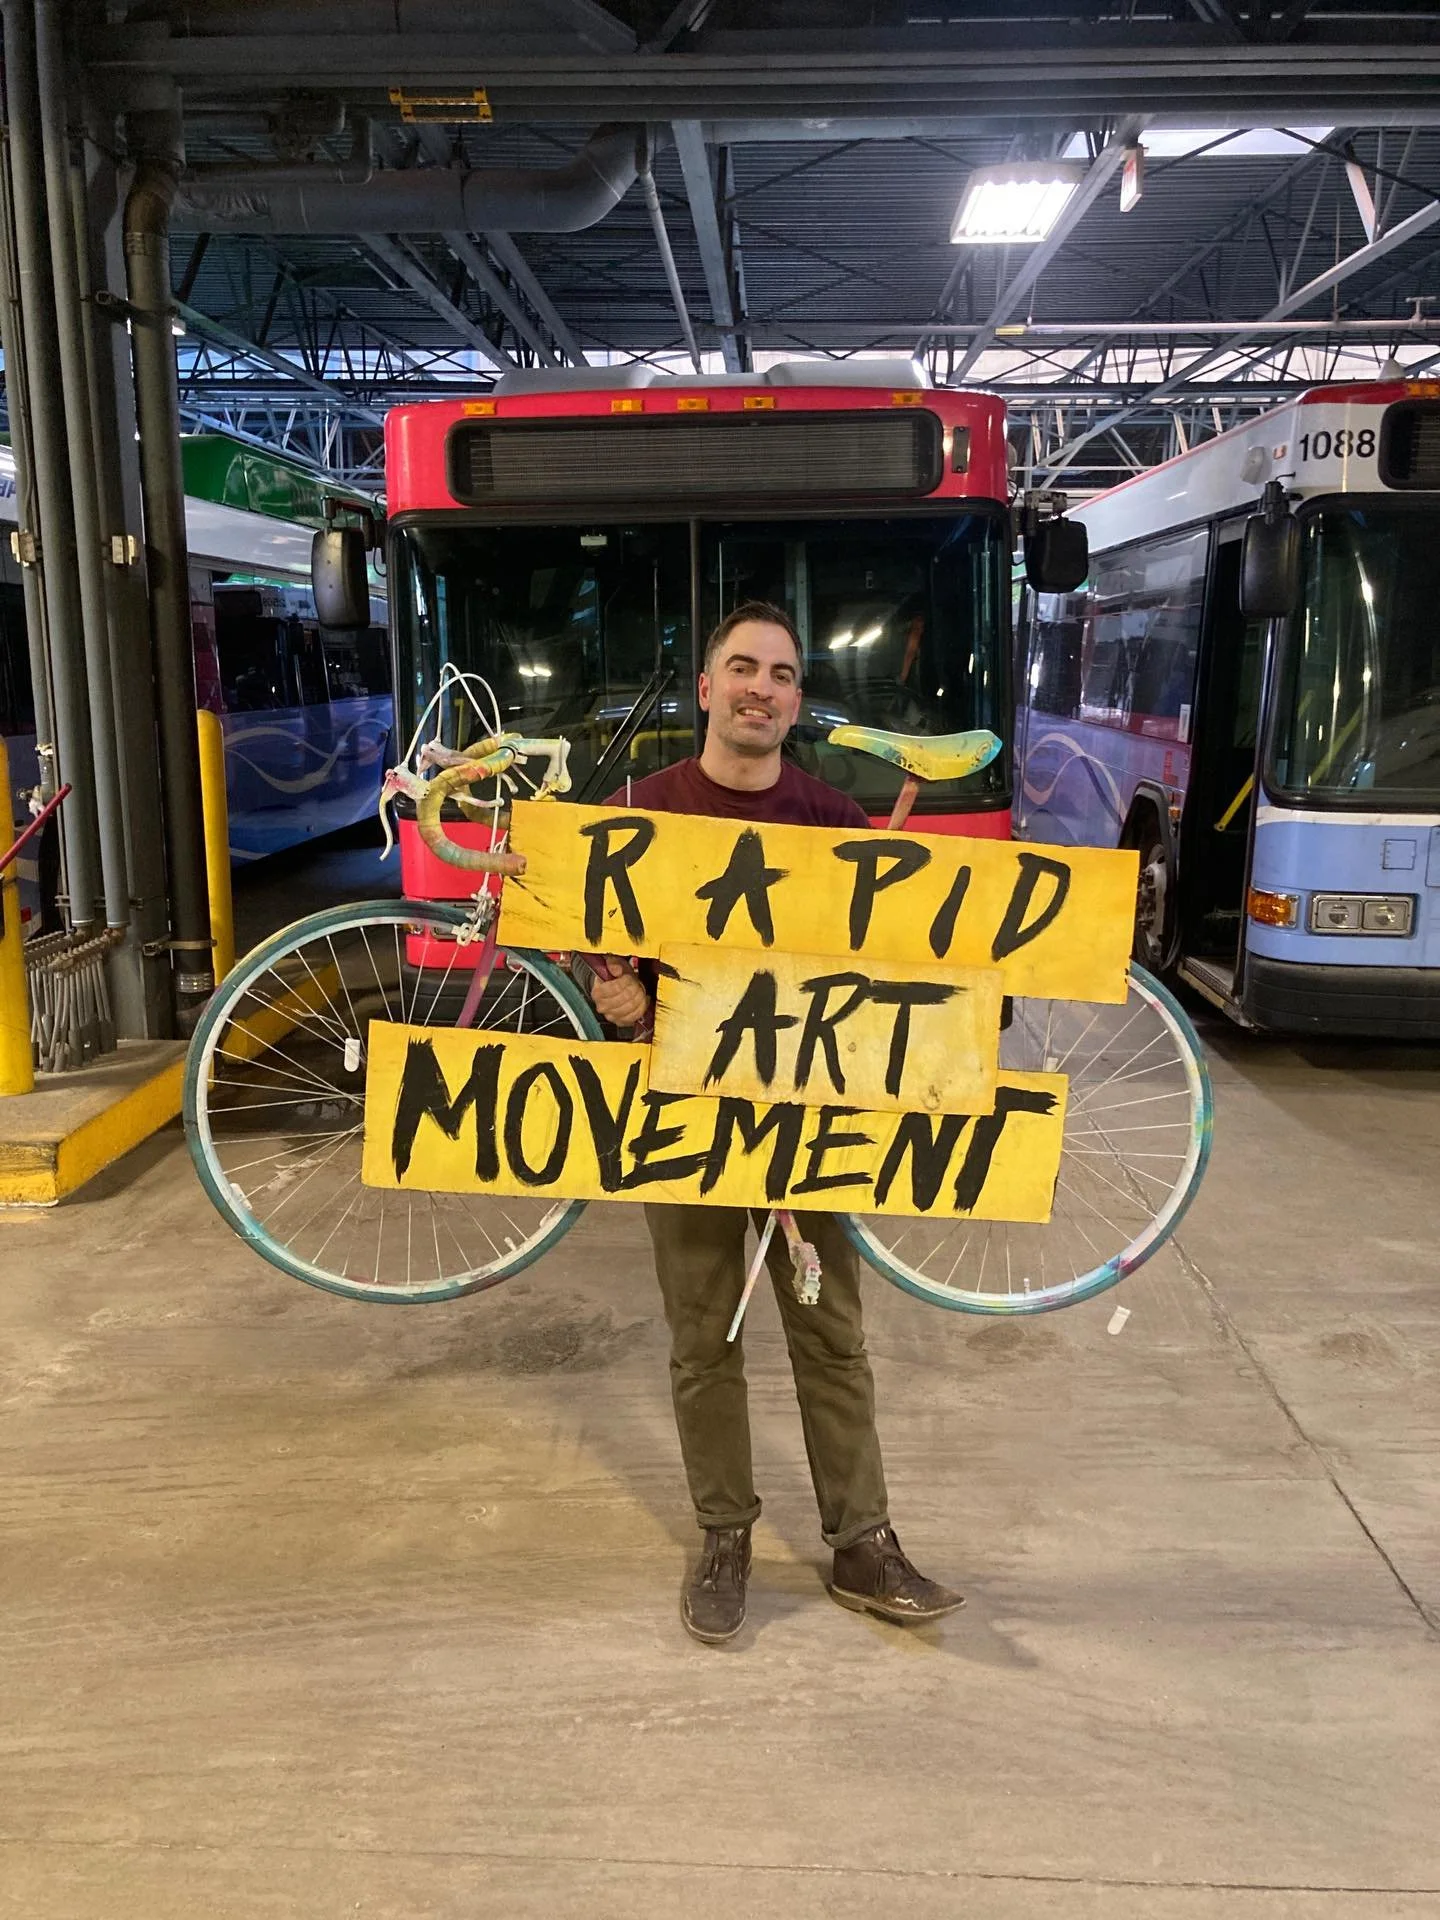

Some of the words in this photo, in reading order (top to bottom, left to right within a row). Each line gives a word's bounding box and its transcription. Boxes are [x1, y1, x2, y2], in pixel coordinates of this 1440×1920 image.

[1299, 429, 1376, 462] 1088
[579, 815, 1072, 963] RAPID
[703, 969, 967, 1097] ART
[391, 1036, 1058, 1213] MOVEMENT
